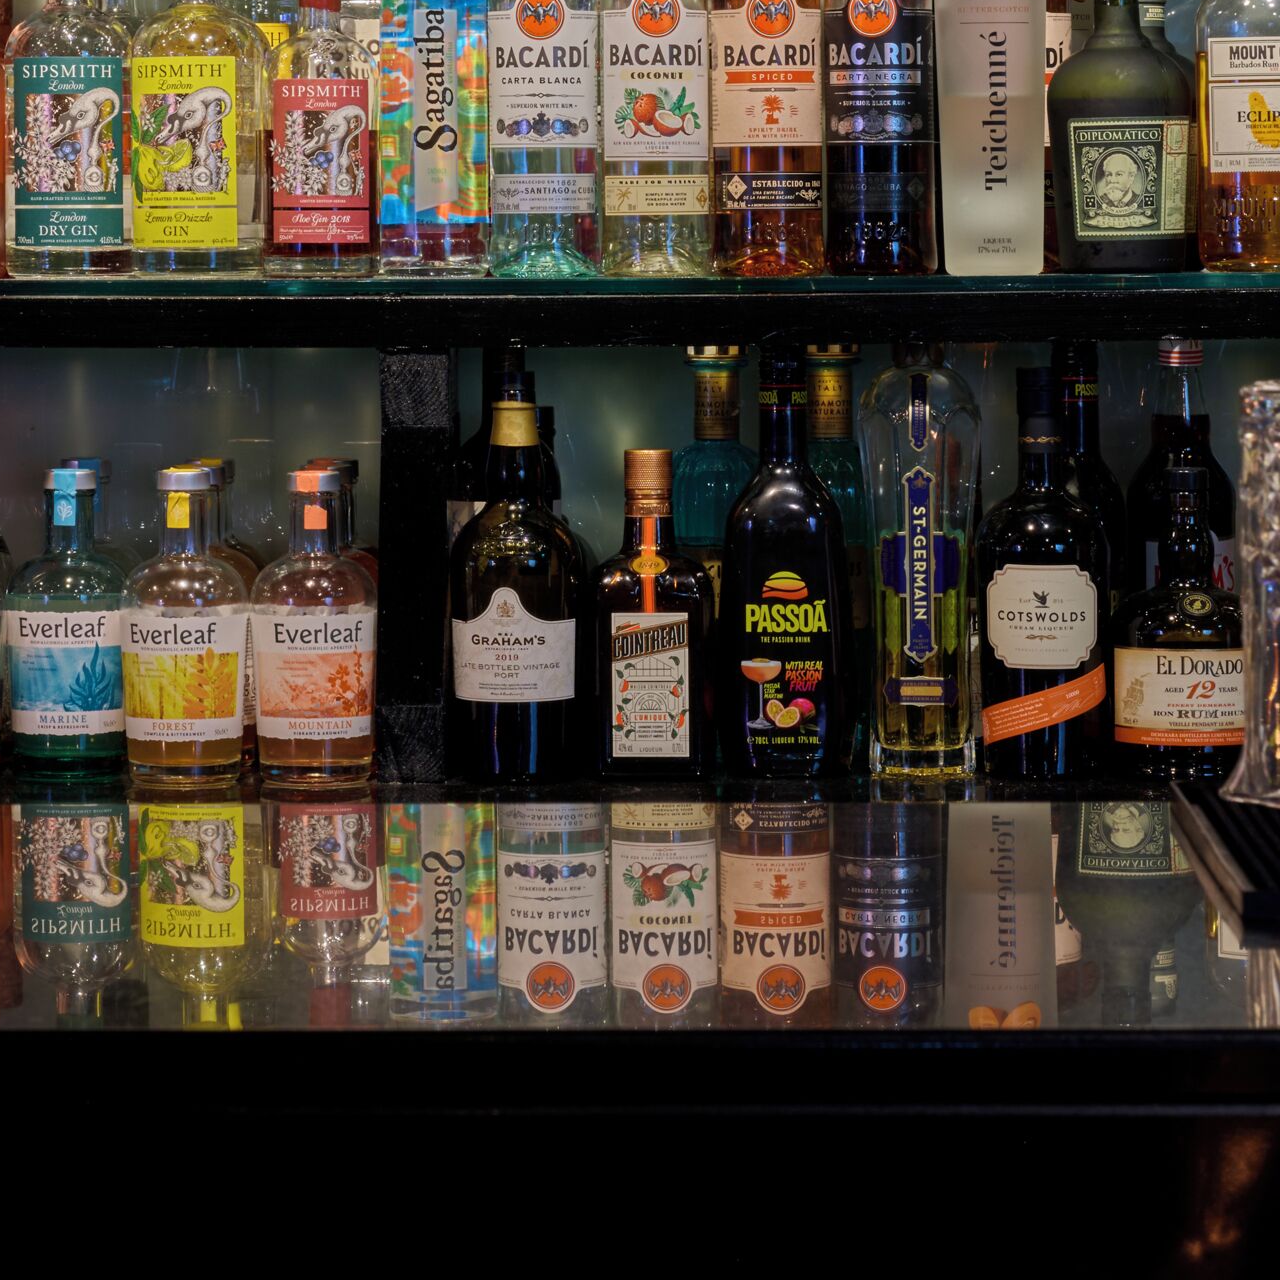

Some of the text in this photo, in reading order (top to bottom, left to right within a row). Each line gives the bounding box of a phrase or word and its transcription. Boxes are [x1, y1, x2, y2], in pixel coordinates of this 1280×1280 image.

[496, 40, 588, 69] BACARDÍ
[609, 38, 703, 68] BACARDÍ
[724, 39, 816, 68] BACARDÍ
[1229, 45, 1277, 61] MOUNT
[22, 64, 112, 80] SIPSMITH
[138, 64, 223, 80] SIPSMITH
[630, 72, 684, 80] COCONUT
[751, 73, 794, 82] SPICED
[414, 8, 458, 154] Sagatiba
[502, 76, 582, 85] CARTA BLANCA
[282, 84, 361, 99] SIPSMITH
[980, 31, 1008, 192] Teichenné
[1079, 128, 1158, 142] DIPLOMÁTICO
[38, 224, 98, 237] DRY GIN
[745, 599, 829, 634] PASSOÃ
[998, 610, 1087, 623] COTSWOLDS
[18, 616, 106, 639] Everleaf
[130, 622, 218, 646] Everleaf
[274, 620, 364, 644] Everleaf
[471, 634, 546, 648] GRAHAM'S
[613, 622, 687, 659] COINTREAU
[1156, 655, 1244, 678] EL DORADO
[1164, 680, 1239, 701] AGED 12 YEARS
[39, 714, 88, 724] MARINE
[152, 722, 196, 732] FOREST
[288, 720, 353, 730] MOUNTAIN
